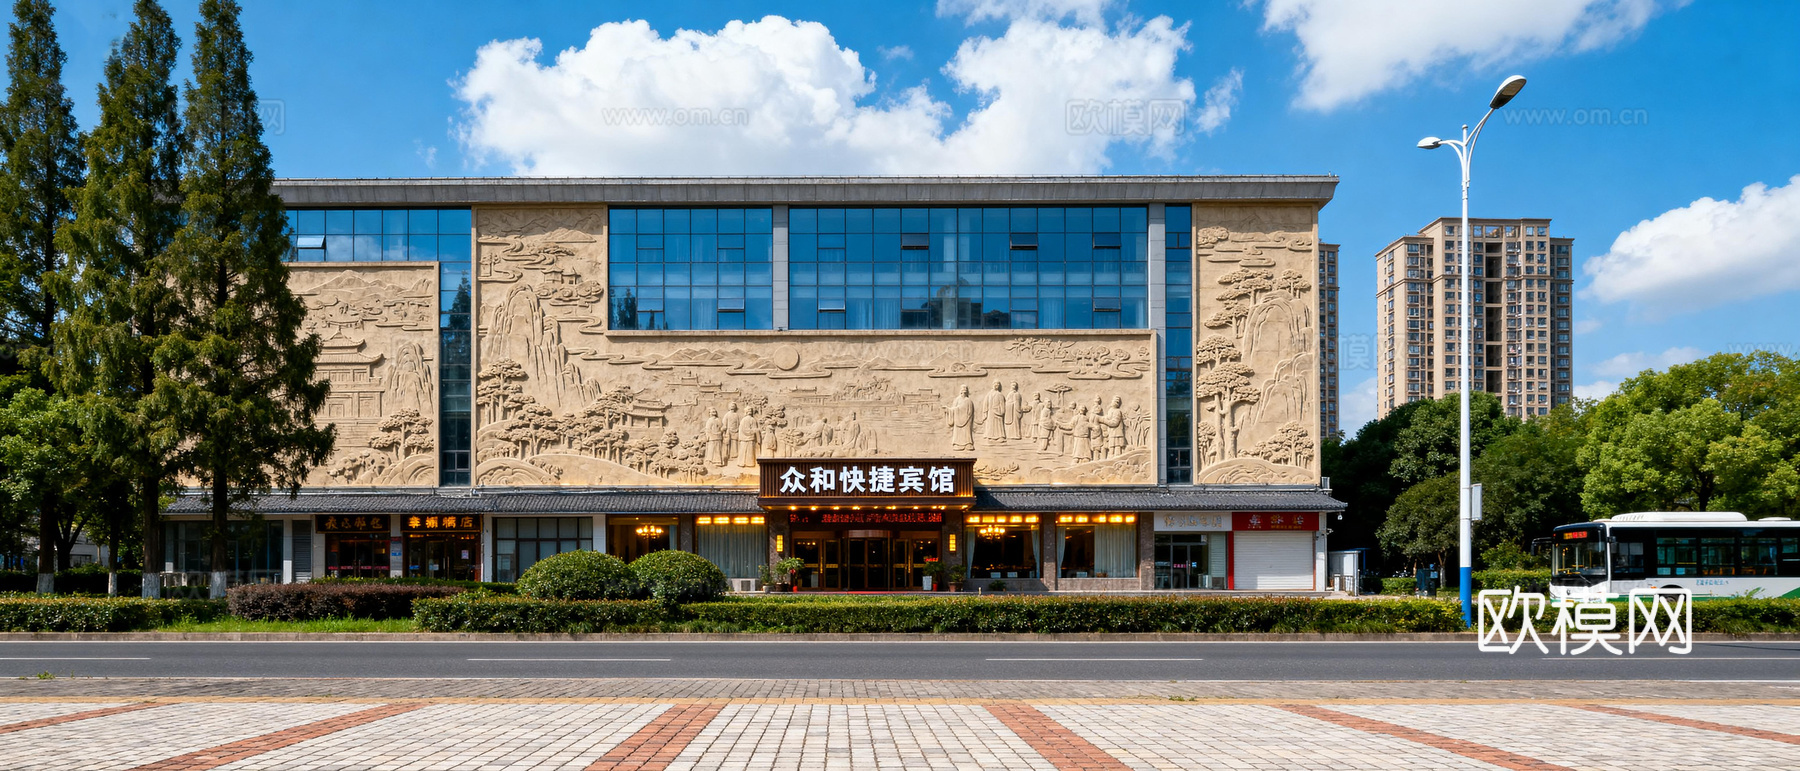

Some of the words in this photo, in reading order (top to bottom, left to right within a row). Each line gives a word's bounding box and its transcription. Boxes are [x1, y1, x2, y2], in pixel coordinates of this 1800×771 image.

[779, 466, 955, 493] 众和快捷宾馆
